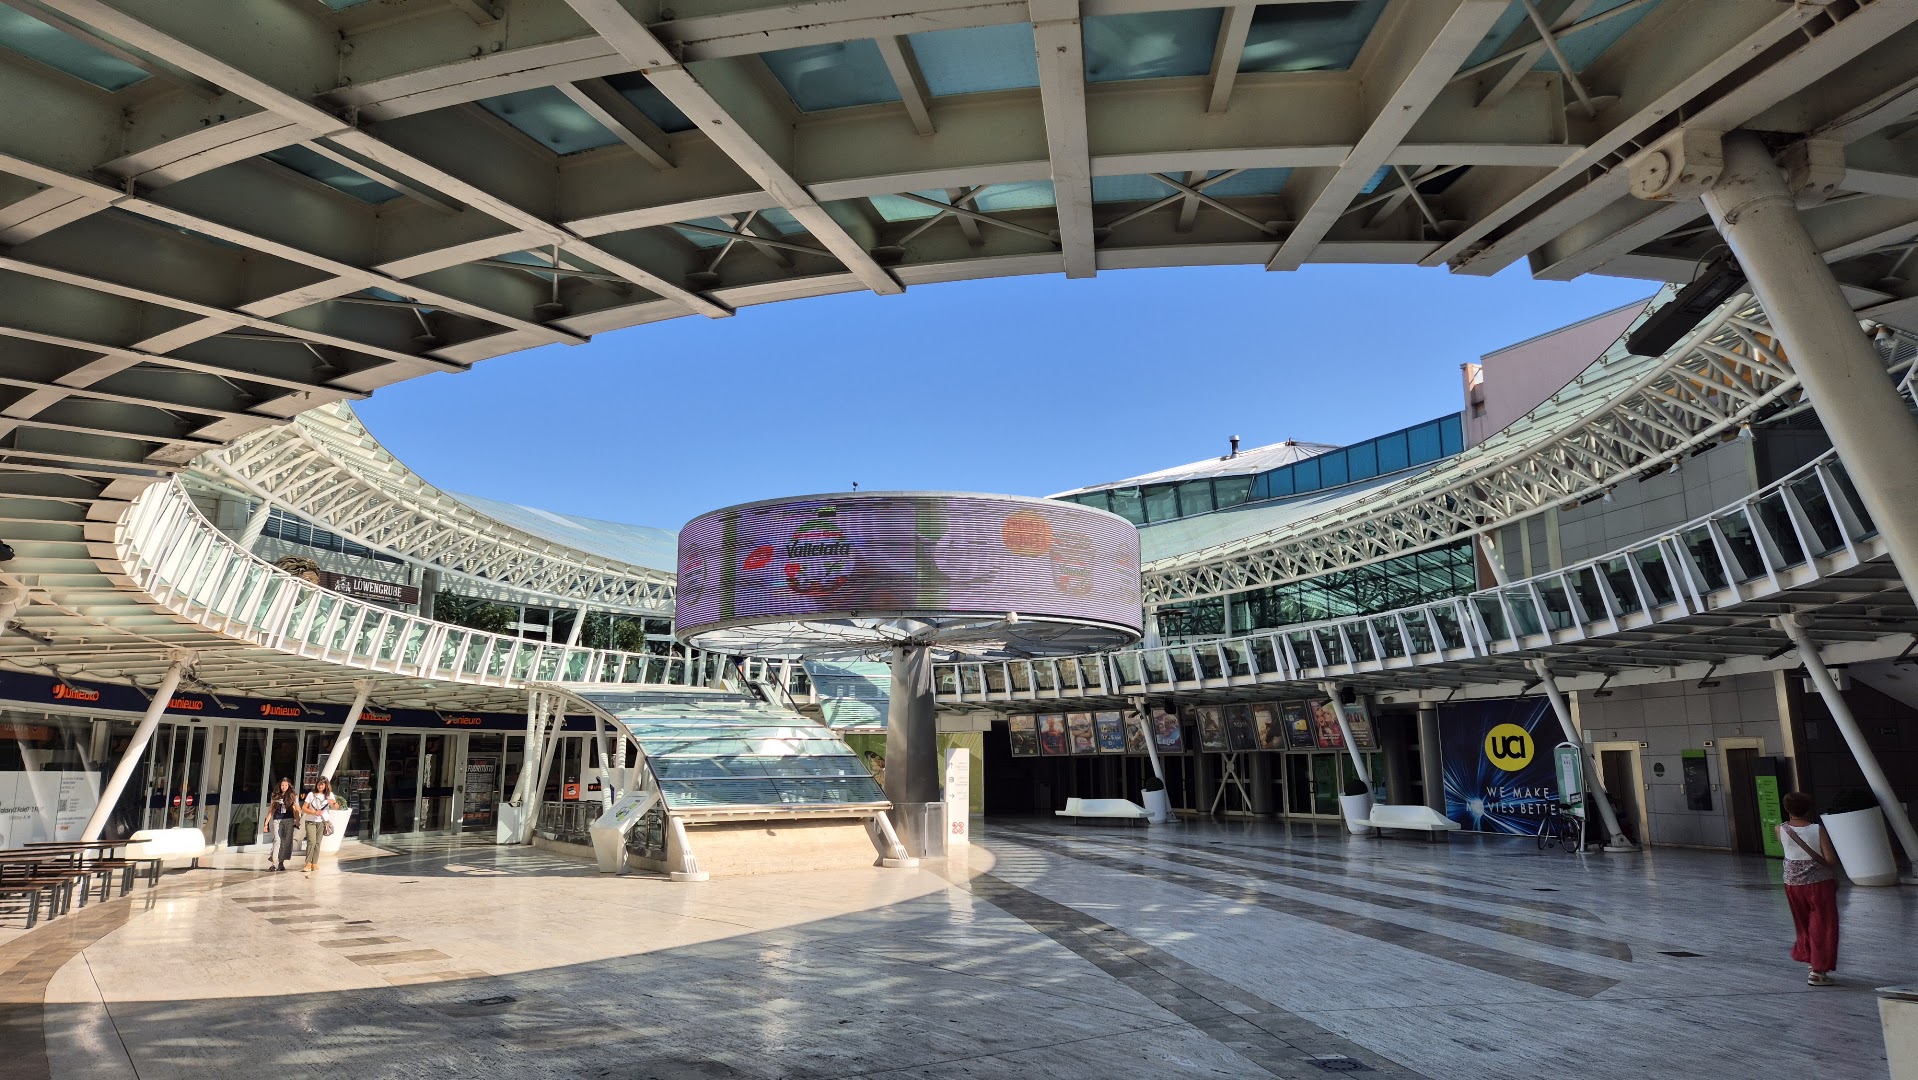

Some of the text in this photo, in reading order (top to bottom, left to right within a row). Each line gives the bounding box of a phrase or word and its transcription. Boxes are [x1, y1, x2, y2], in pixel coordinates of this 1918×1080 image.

[353, 578, 402, 597] LÖWENGRUBE
[269, 705, 300, 716] unieuro
[1491, 735, 1526, 759] UCI
[1486, 786, 1550, 799] WE MAKE
